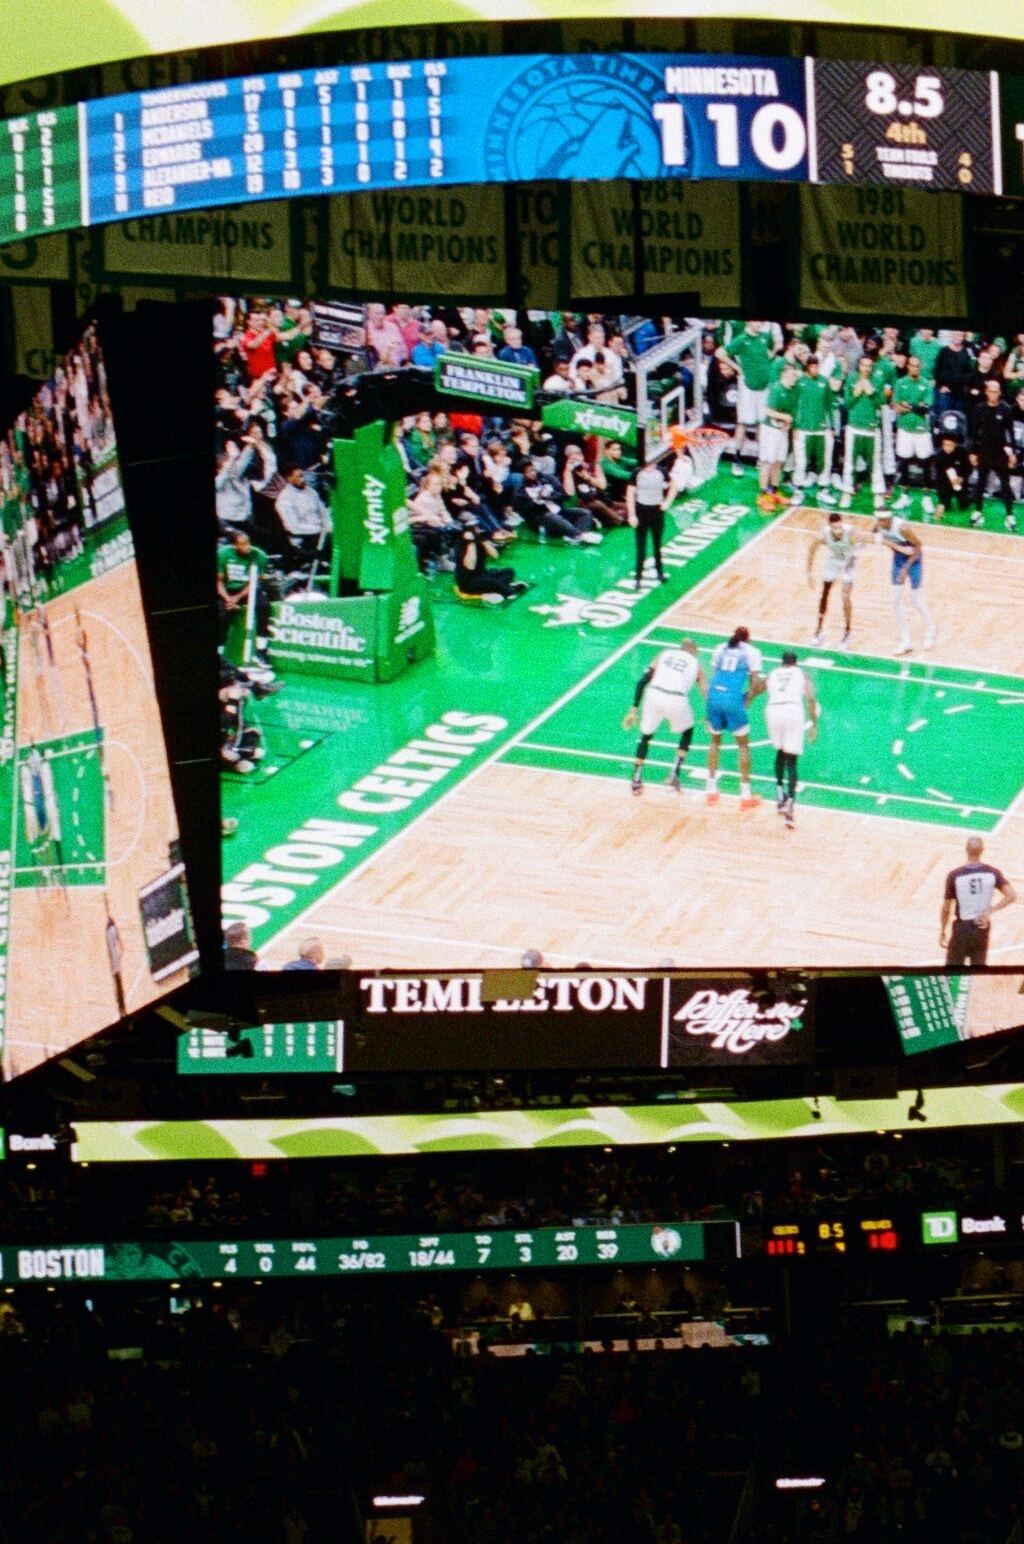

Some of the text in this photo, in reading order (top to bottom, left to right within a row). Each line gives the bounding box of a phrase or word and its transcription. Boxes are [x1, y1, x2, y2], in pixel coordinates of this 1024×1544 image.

[664, 67, 779, 97] MINNESOTA
[865, 71, 945, 119] 8.5
[652, 102, 807, 171] 110
[885, 121, 927, 145] 4th
[637, 181, 686, 203] 984
[371, 194, 465, 228] WORLD
[611, 208, 704, 239] WORLD
[121, 216, 273, 249] CHAMPIONS
[341, 227, 498, 265] CHAMPIONS
[837, 219, 927, 253] WORLD
[582, 240, 734, 277] CHAMPIONS
[807, 254, 959, 287] CHAMPIONS
[574, 408, 632, 436] xfinity
[361, 473, 387, 545] xfinity
[221, 818, 378, 930] OSTON
[338, 709, 509, 813] CELTICS
[360, 977, 649, 1013] TEMETON
[926, 1215, 1006, 1238] TD Bank
[18, 1249, 105, 1280] BOSTON
[224, 1258, 237, 1273] 4
[294, 1256, 317, 1272] 44
[477, 1248, 491, 1263] 7
[519, 1247, 532, 1262] 3
[556, 1245, 578, 1261] 20
[597, 1244, 618, 1259] 39
